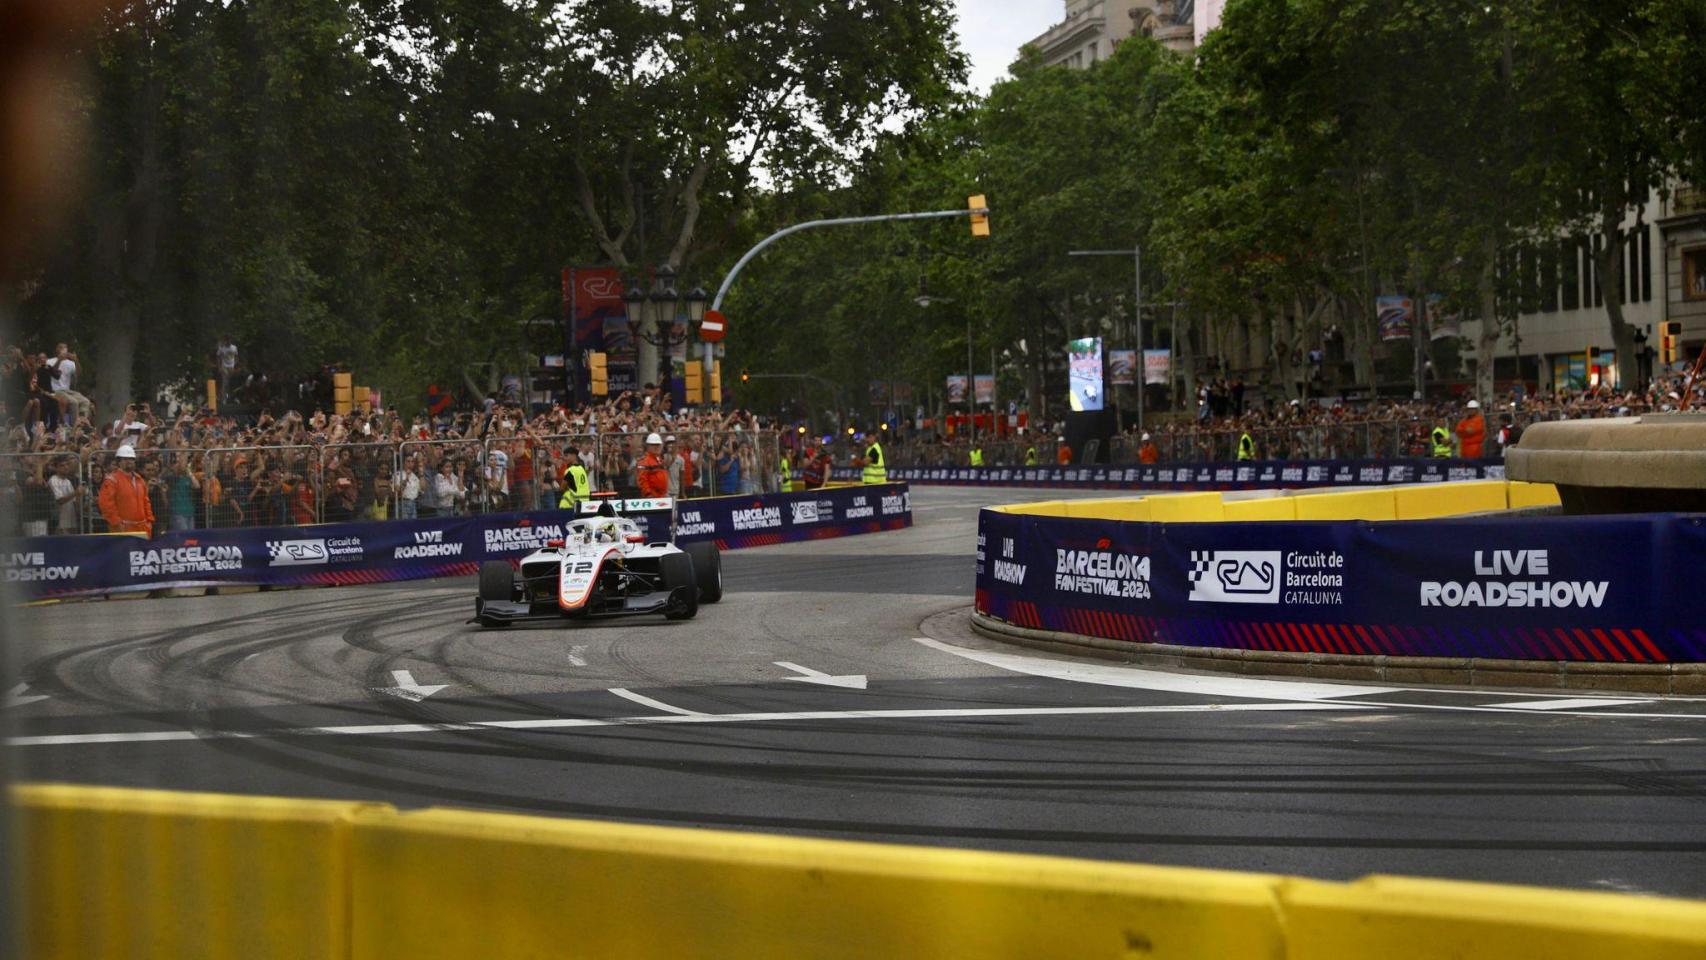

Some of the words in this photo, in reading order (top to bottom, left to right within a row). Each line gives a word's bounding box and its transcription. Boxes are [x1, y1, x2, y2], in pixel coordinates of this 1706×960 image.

[682, 511, 701, 523] LIVE
[732, 506, 780, 523] BARCELONA
[414, 530, 442, 544] LIVE
[484, 525, 563, 543] BARCELONA
[670, 522, 715, 536] OADSHOW
[327, 537, 350, 547] Circuit
[351, 536, 361, 546] de
[329, 545, 363, 554] Barcelona
[486, 542, 503, 552] FAN
[504, 539, 542, 551] FESTIVAL
[1003, 537, 1014, 558] LIVE
[129, 546, 243, 566] BARCELONA
[394, 543, 463, 559] ROADSHOW
[0, 552, 45, 567] LIVE
[131, 565, 159, 576] FAN
[162, 561, 214, 574] FESTIVAL
[214, 559, 243, 570] 2024
[564, 561, 593, 574] 12
[1056, 548, 1151, 582] BARCELONA
[1287, 551, 1326, 568] Circuit
[1328, 551, 1344, 568] de
[1474, 549, 1549, 576] LIVE
[1055, 573, 1075, 592] FAN
[1075, 576, 1121, 597] FESTIVAL
[1121, 580, 1152, 600] 2024
[1286, 571, 1343, 587] Barcelona
[1284, 591, 1342, 605] CATALUNYA
[1420, 580, 1609, 608] ROADSHOW
